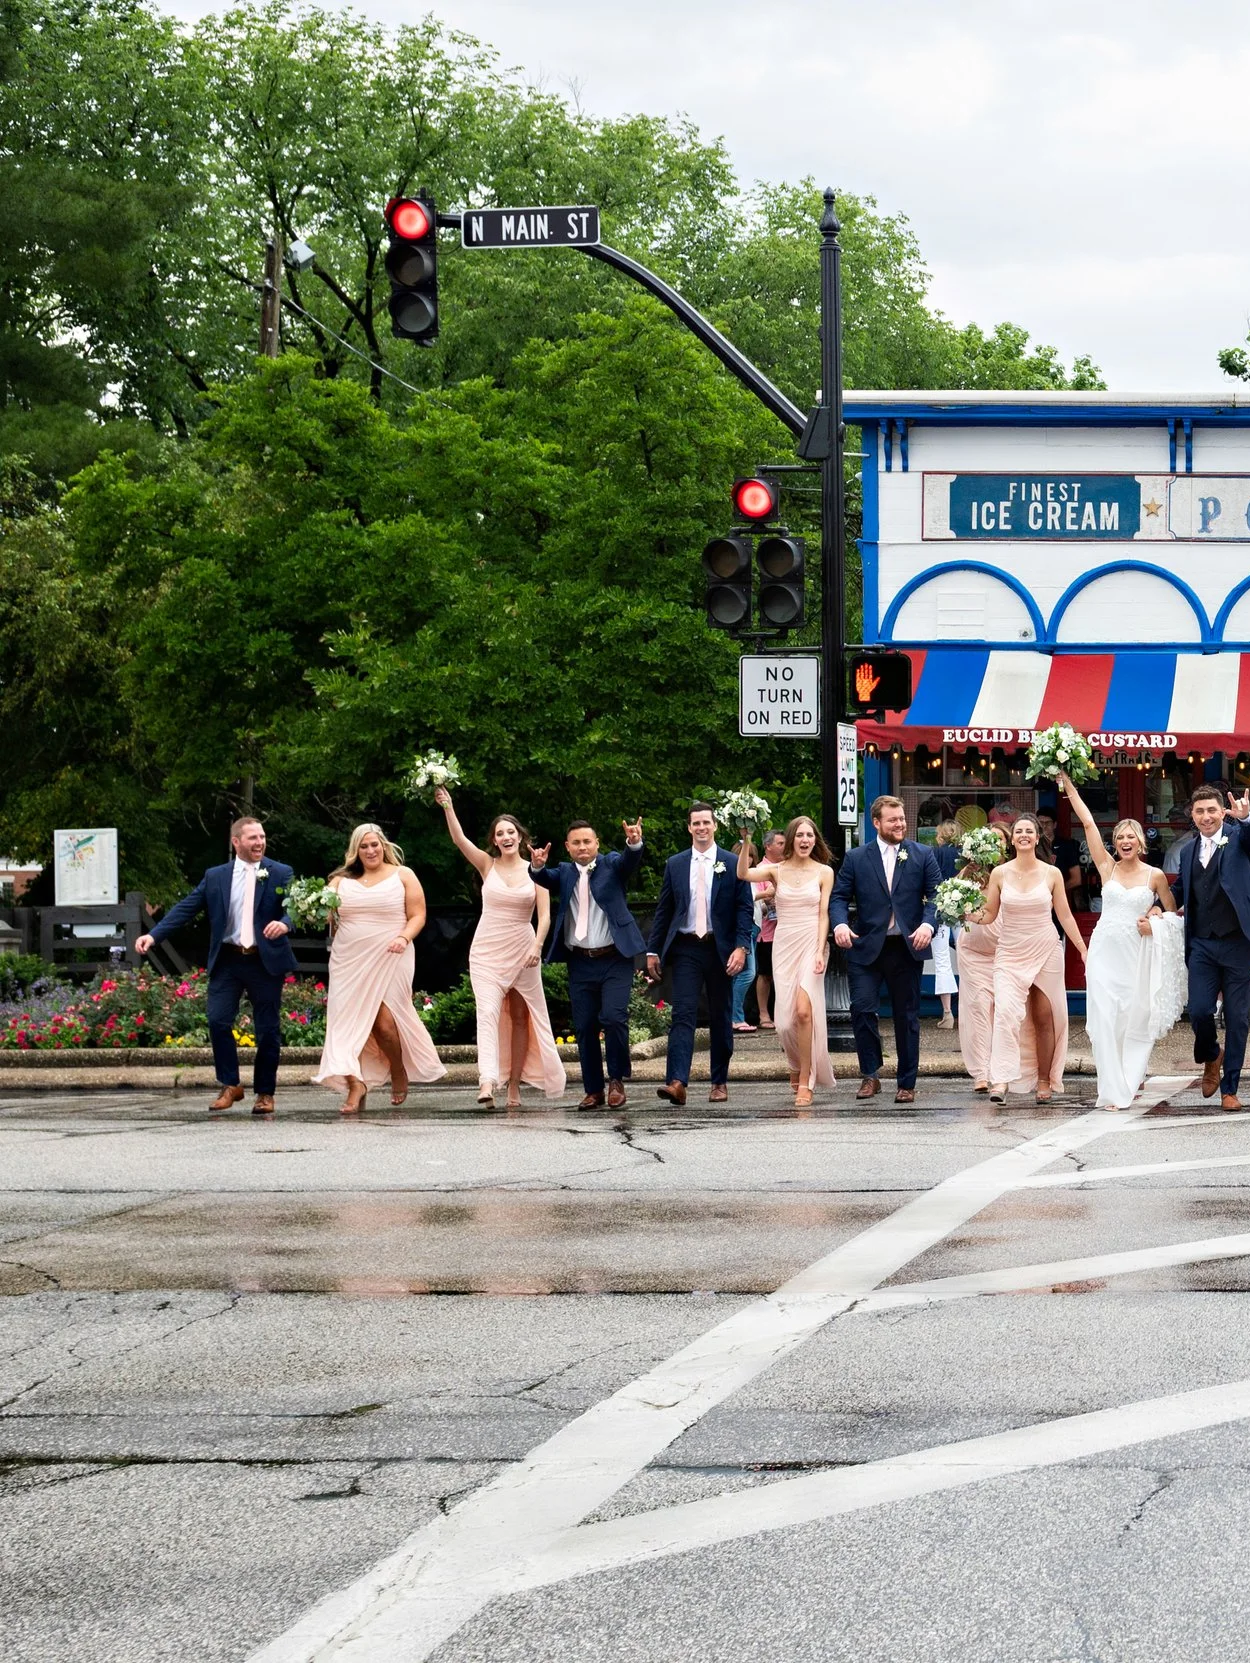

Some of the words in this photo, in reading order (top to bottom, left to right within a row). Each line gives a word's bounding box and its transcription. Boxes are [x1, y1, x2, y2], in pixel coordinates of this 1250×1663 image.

[472, 216, 483, 241] N
[501, 214, 549, 240] MAIN
[567, 213, 589, 239] ST
[1009, 482, 1082, 501] FINEST
[971, 501, 1012, 530] ICE
[1028, 502, 1119, 531] CREAM
[766, 667, 794, 681] NO
[758, 689, 802, 703] TURN
[748, 711, 770, 725] ON
[781, 711, 812, 725] RED
[943, 729, 1013, 742] EUCLID
[1087, 733, 1178, 748] CUSTARD
[839, 736, 856, 752] SPEED
[841, 758, 854, 772] LIMIT
[840, 777, 856, 813] 25
